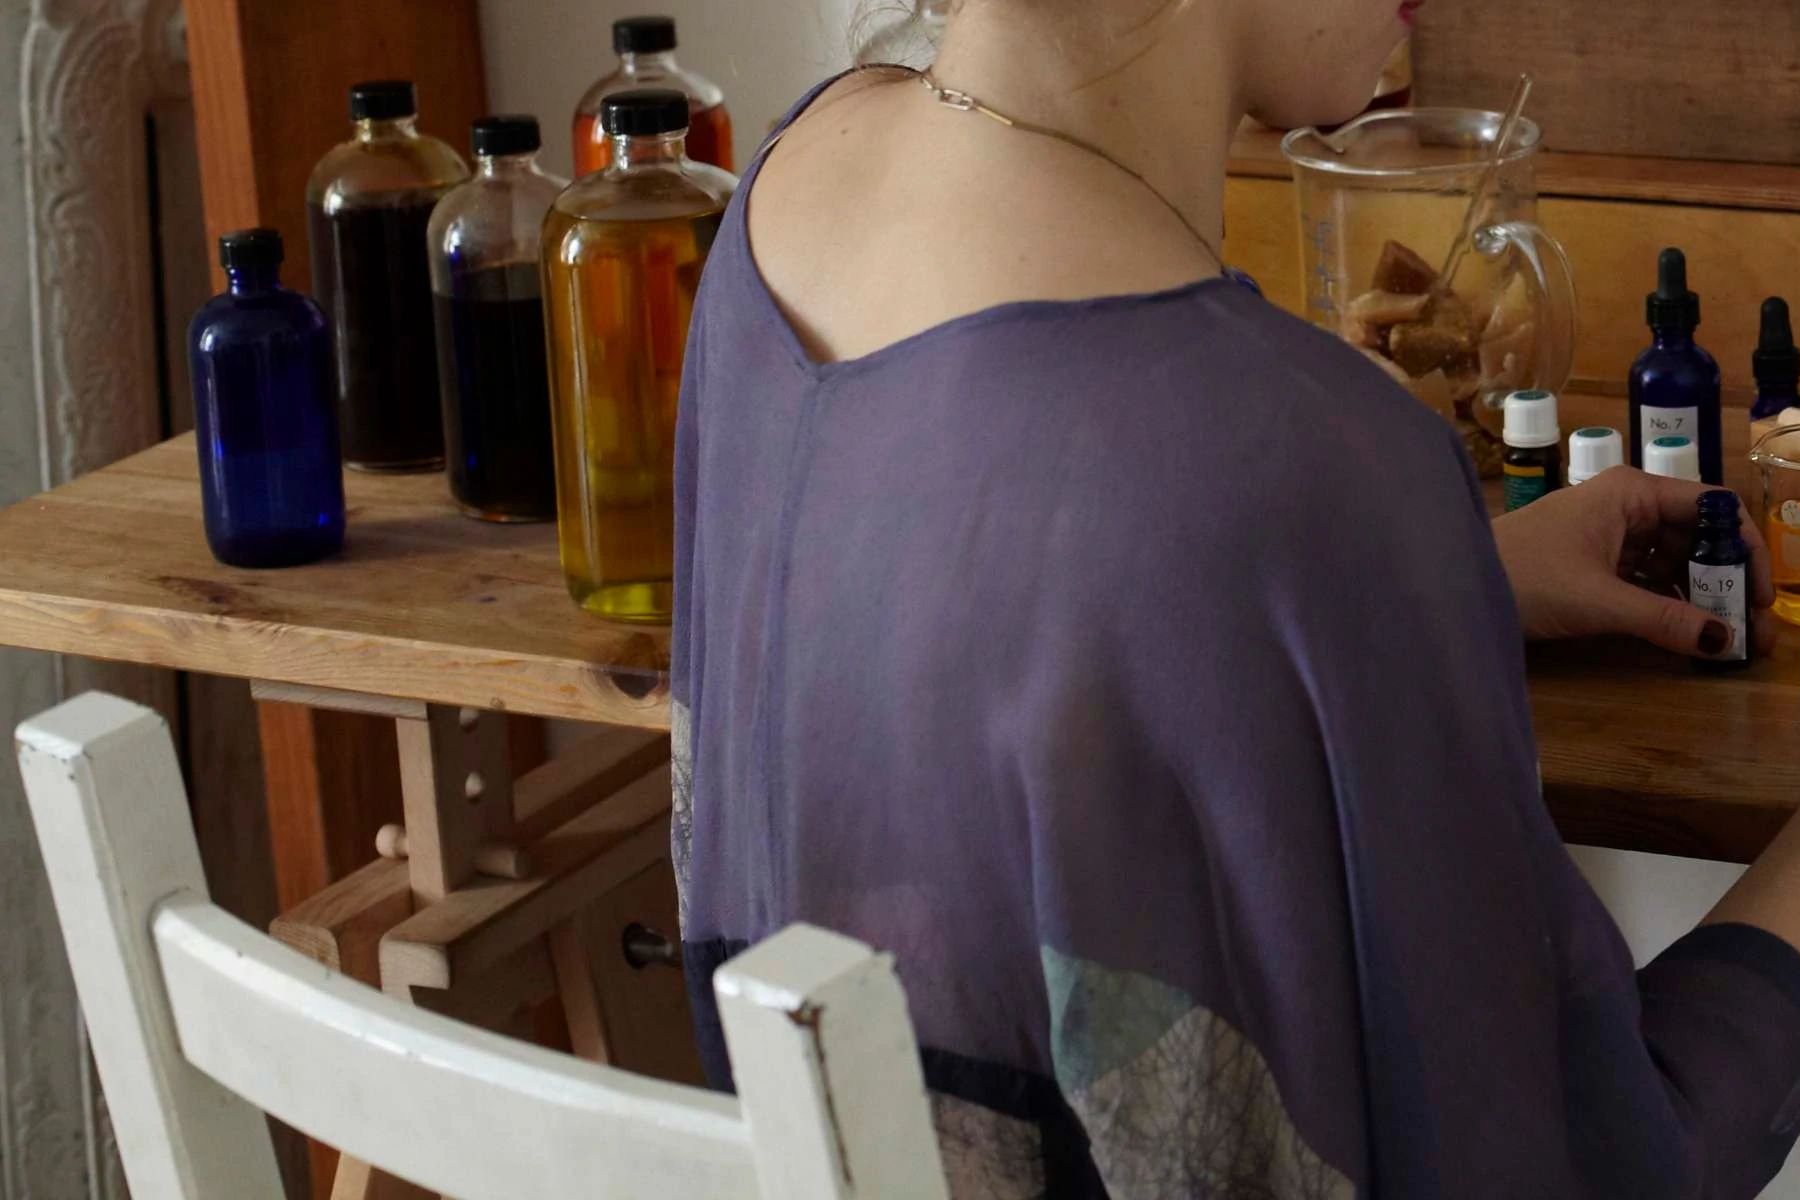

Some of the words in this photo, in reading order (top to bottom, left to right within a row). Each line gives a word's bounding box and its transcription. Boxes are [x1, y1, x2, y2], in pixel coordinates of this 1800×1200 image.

[1650, 417, 1671, 431] No.
[1674, 417, 1684, 430] 7
[1692, 576, 1712, 593] No.
[1717, 578, 1735, 593] 19
